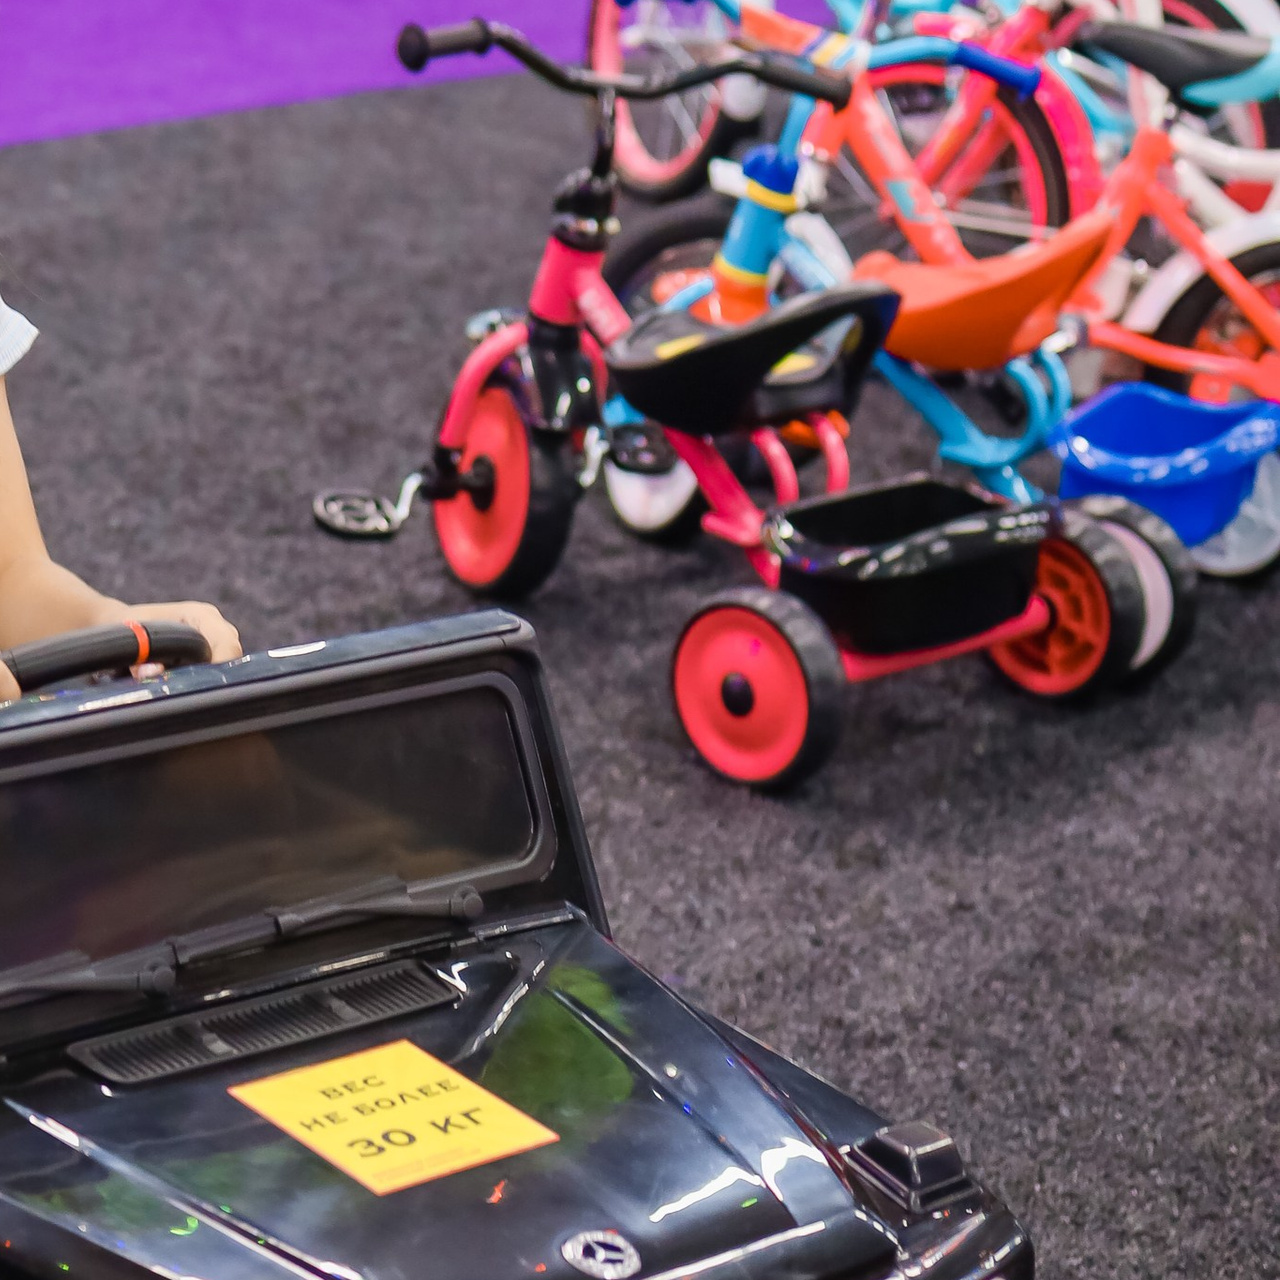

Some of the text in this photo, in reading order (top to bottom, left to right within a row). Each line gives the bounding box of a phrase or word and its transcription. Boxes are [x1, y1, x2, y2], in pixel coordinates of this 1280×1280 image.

[320, 1075, 385, 1101] ВЕС
[300, 1079, 461, 1133] НЕ БОЛЕЕ
[347, 1128, 416, 1159] 30
